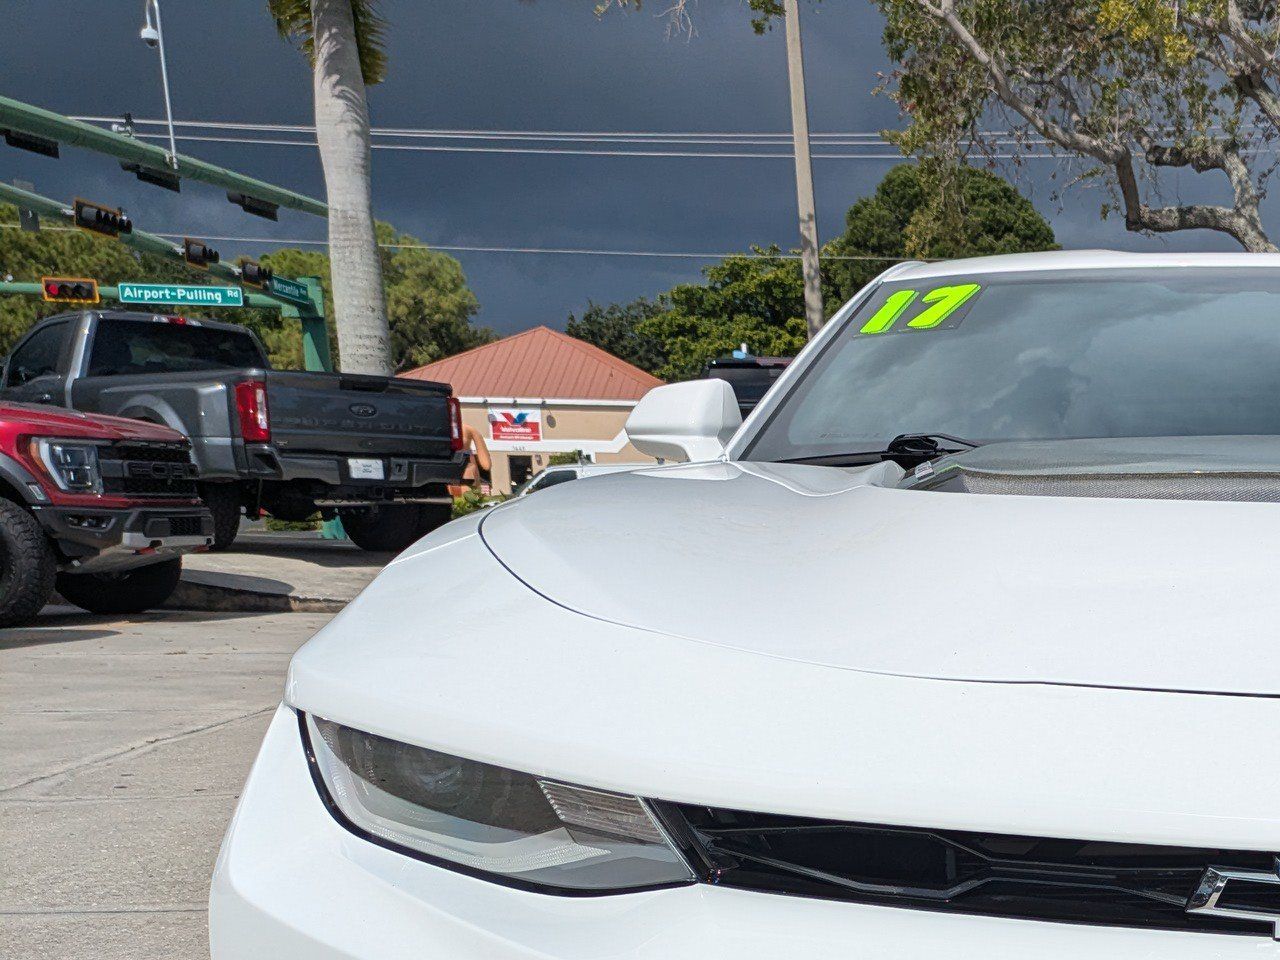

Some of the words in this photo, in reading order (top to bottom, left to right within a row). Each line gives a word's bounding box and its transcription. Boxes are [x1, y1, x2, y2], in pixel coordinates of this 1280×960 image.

[124, 286, 222, 303] Airport-Pulling
[227, 290, 239, 298] Rd
[860, 284, 981, 334] 17
